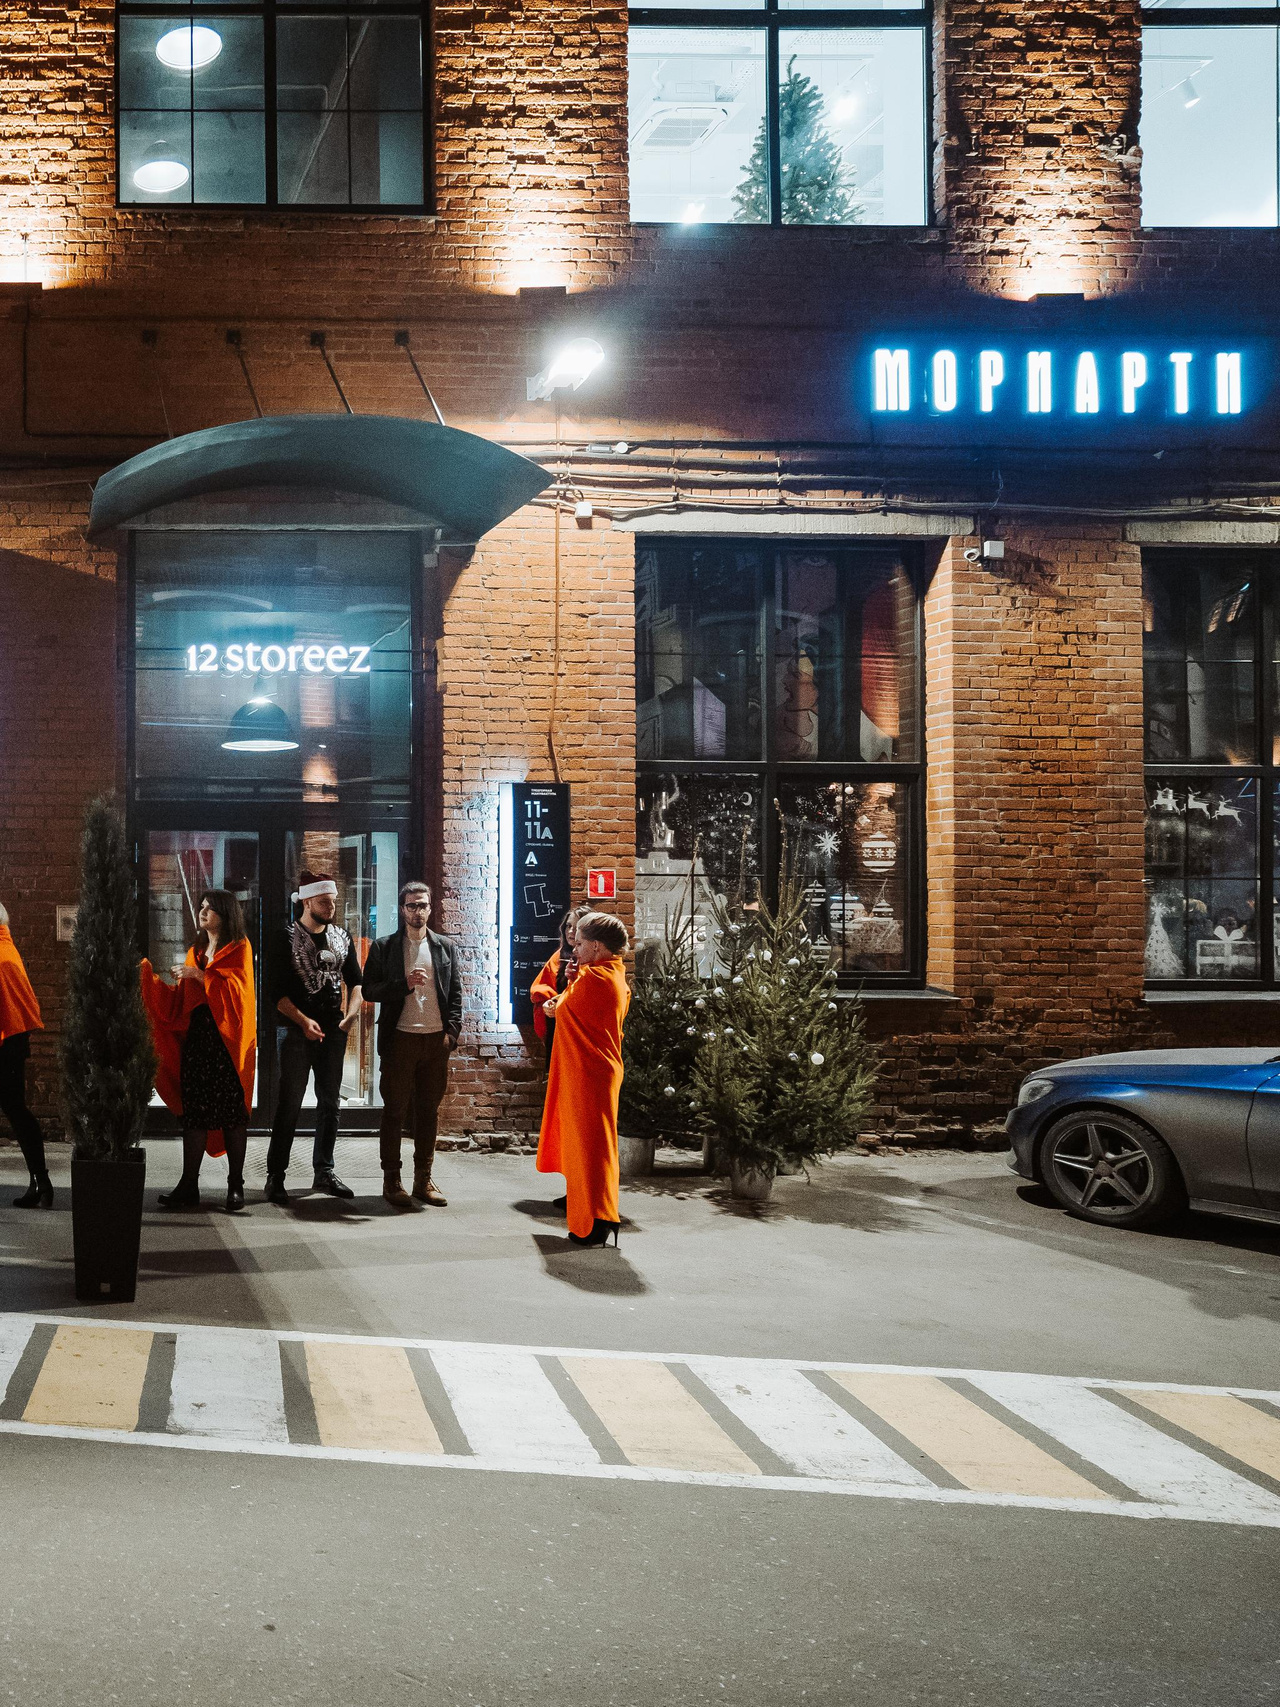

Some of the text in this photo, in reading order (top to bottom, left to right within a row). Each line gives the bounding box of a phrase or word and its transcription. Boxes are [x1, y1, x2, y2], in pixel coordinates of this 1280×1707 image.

[873, 348, 1242, 414] МОРИАРТИ
[187, 642, 372, 673] 12 storeez
[524, 800, 549, 819] 11-
